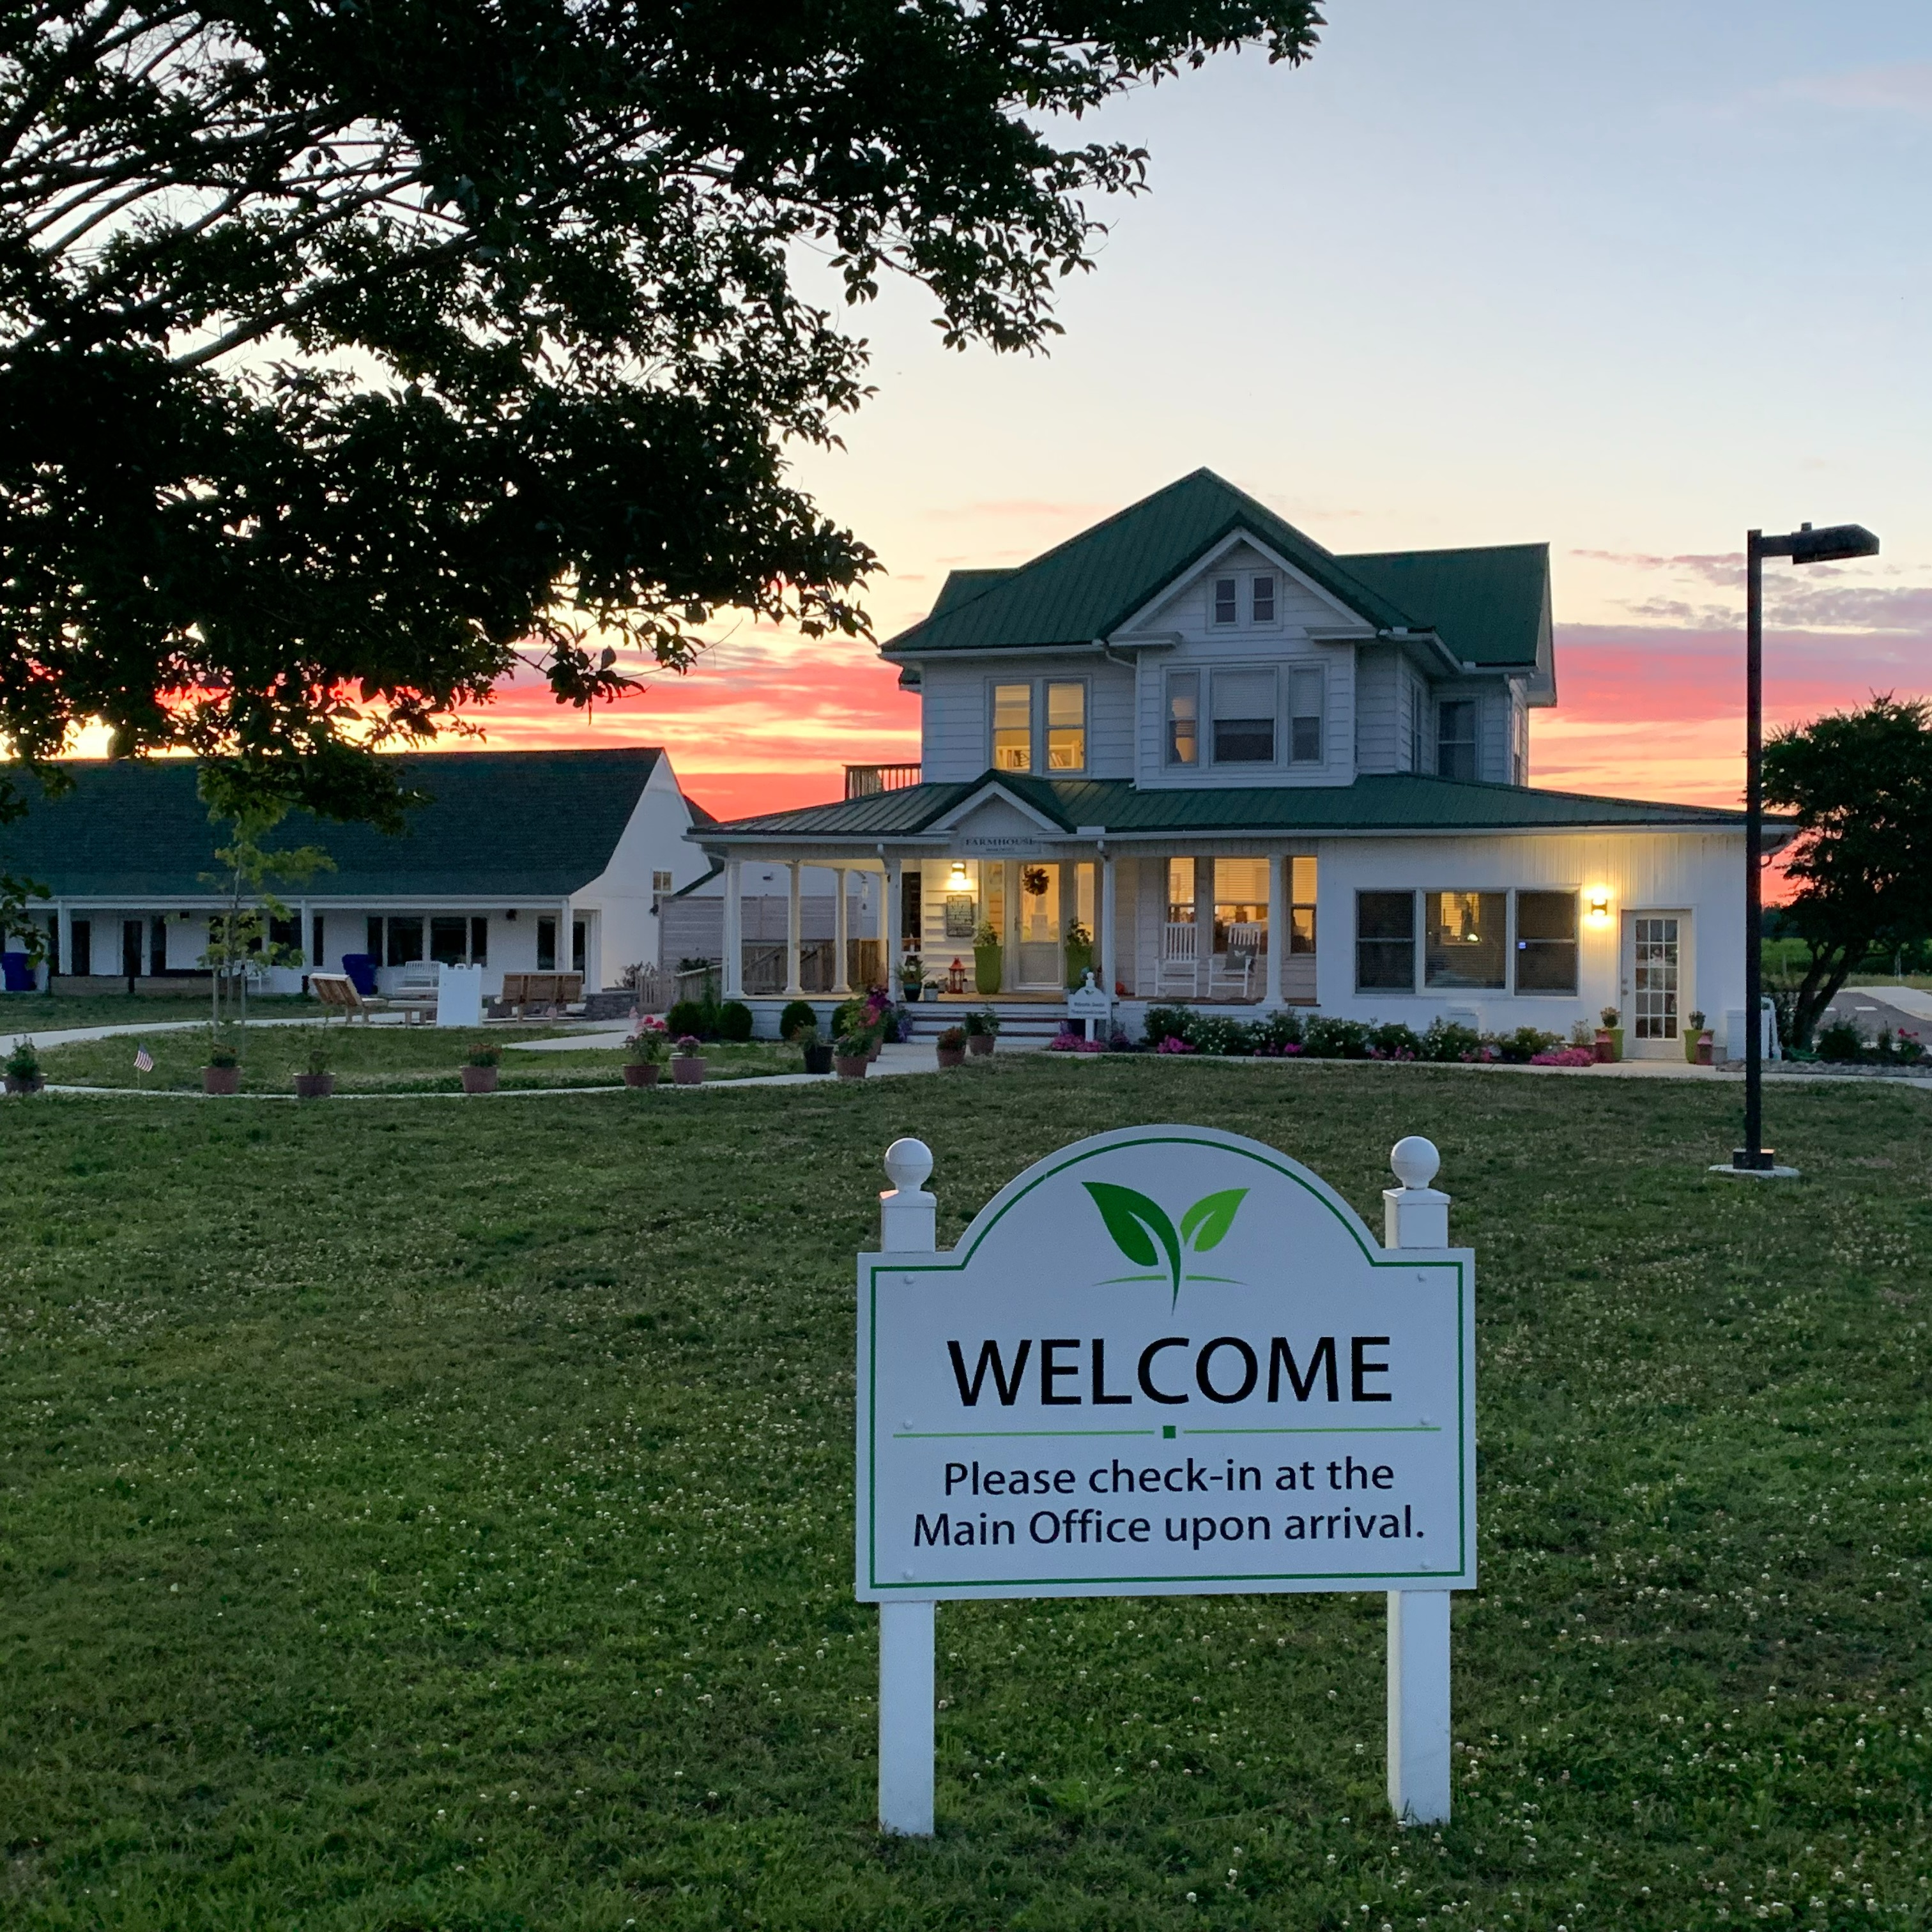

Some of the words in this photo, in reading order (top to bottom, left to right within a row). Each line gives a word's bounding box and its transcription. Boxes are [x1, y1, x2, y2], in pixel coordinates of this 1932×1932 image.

[946, 1336, 1392, 1407] WELCOME
[945, 1460, 1076, 1496] Please
[1089, 1457, 1261, 1493] check-in
[1275, 1461, 1315, 1491] at
[1326, 1455, 1394, 1491] the
[914, 1512, 1015, 1547] Main
[1029, 1508, 1151, 1544] Office
[1165, 1517, 1270, 1551] upon
[1284, 1504, 1424, 1540] arrival.
